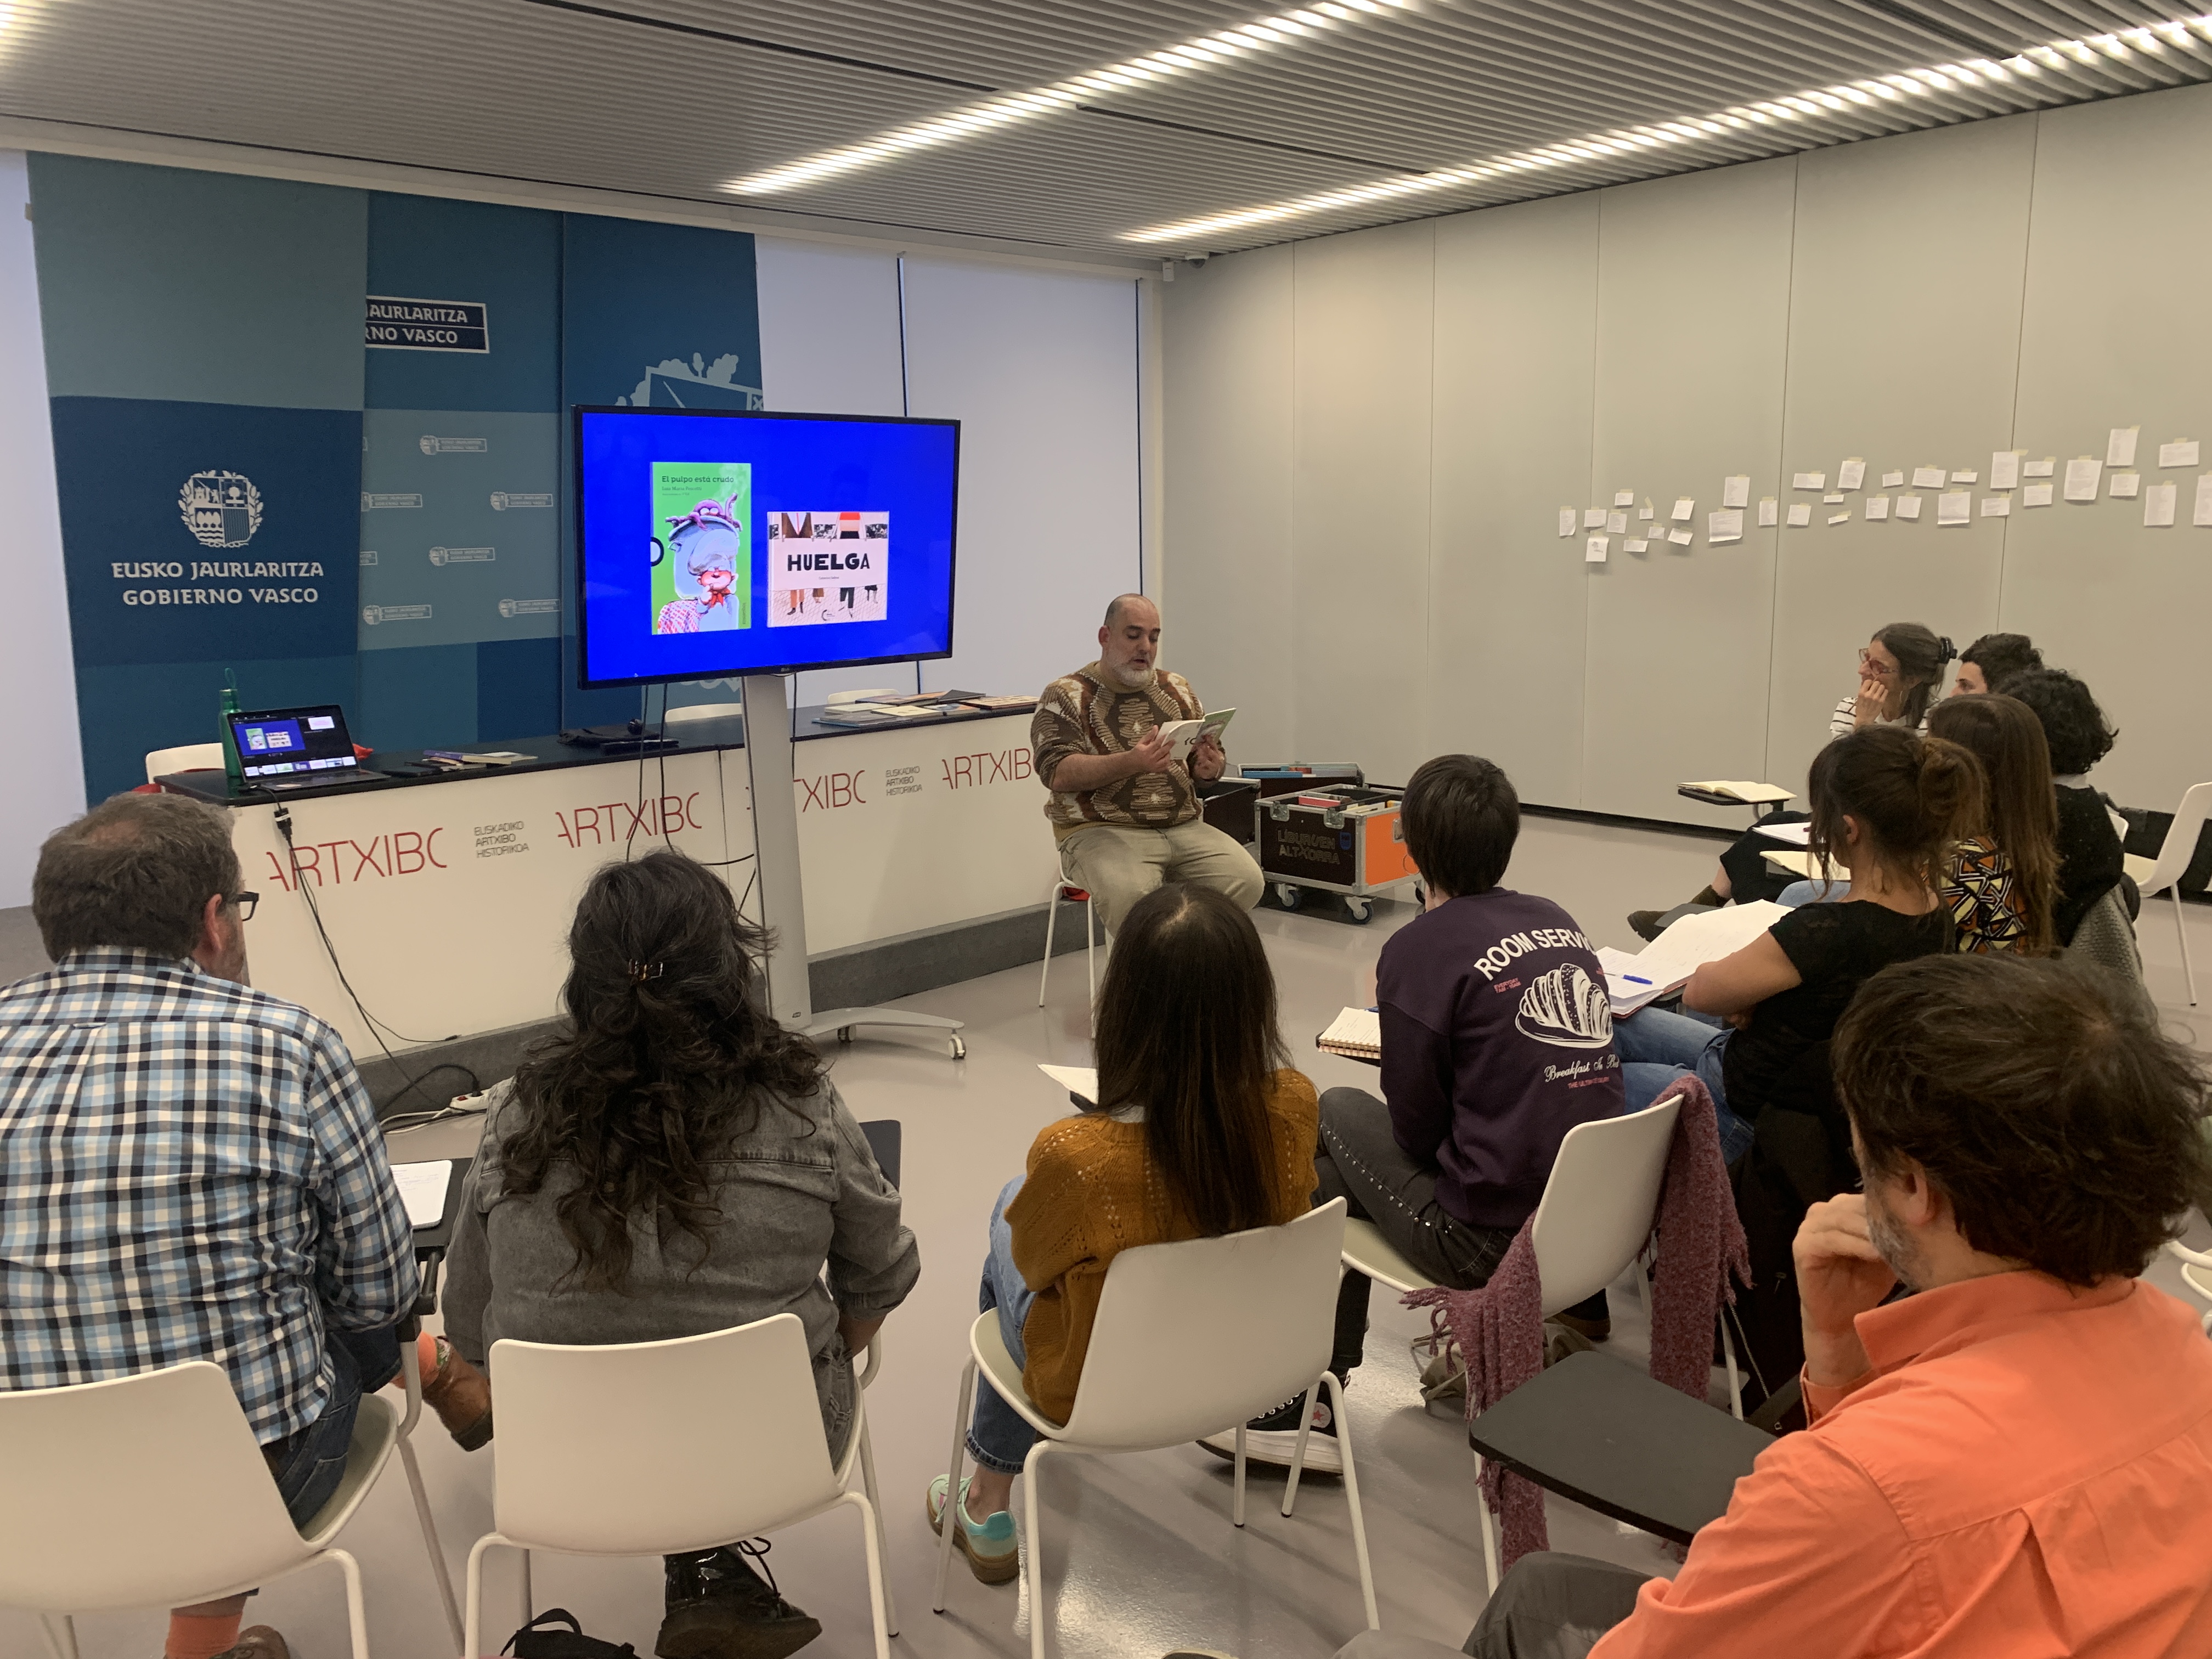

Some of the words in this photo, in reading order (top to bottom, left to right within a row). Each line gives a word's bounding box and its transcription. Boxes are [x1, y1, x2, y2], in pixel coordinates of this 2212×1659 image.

[402, 328, 458, 343] VASCO
[111, 562, 183, 578] EUSKO
[190, 562, 324, 580] JAURLARITZA
[787, 553, 870, 571] HUELGA
[122, 589, 243, 605] GOBIERNO
[249, 588, 318, 603] VASCO
[941, 748, 1031, 789] ARTXIB
[476, 833, 516, 847] ARTXIBO
[1474, 932, 1538, 981] ROOM
[1544, 1060, 1590, 1082] Breakfast
